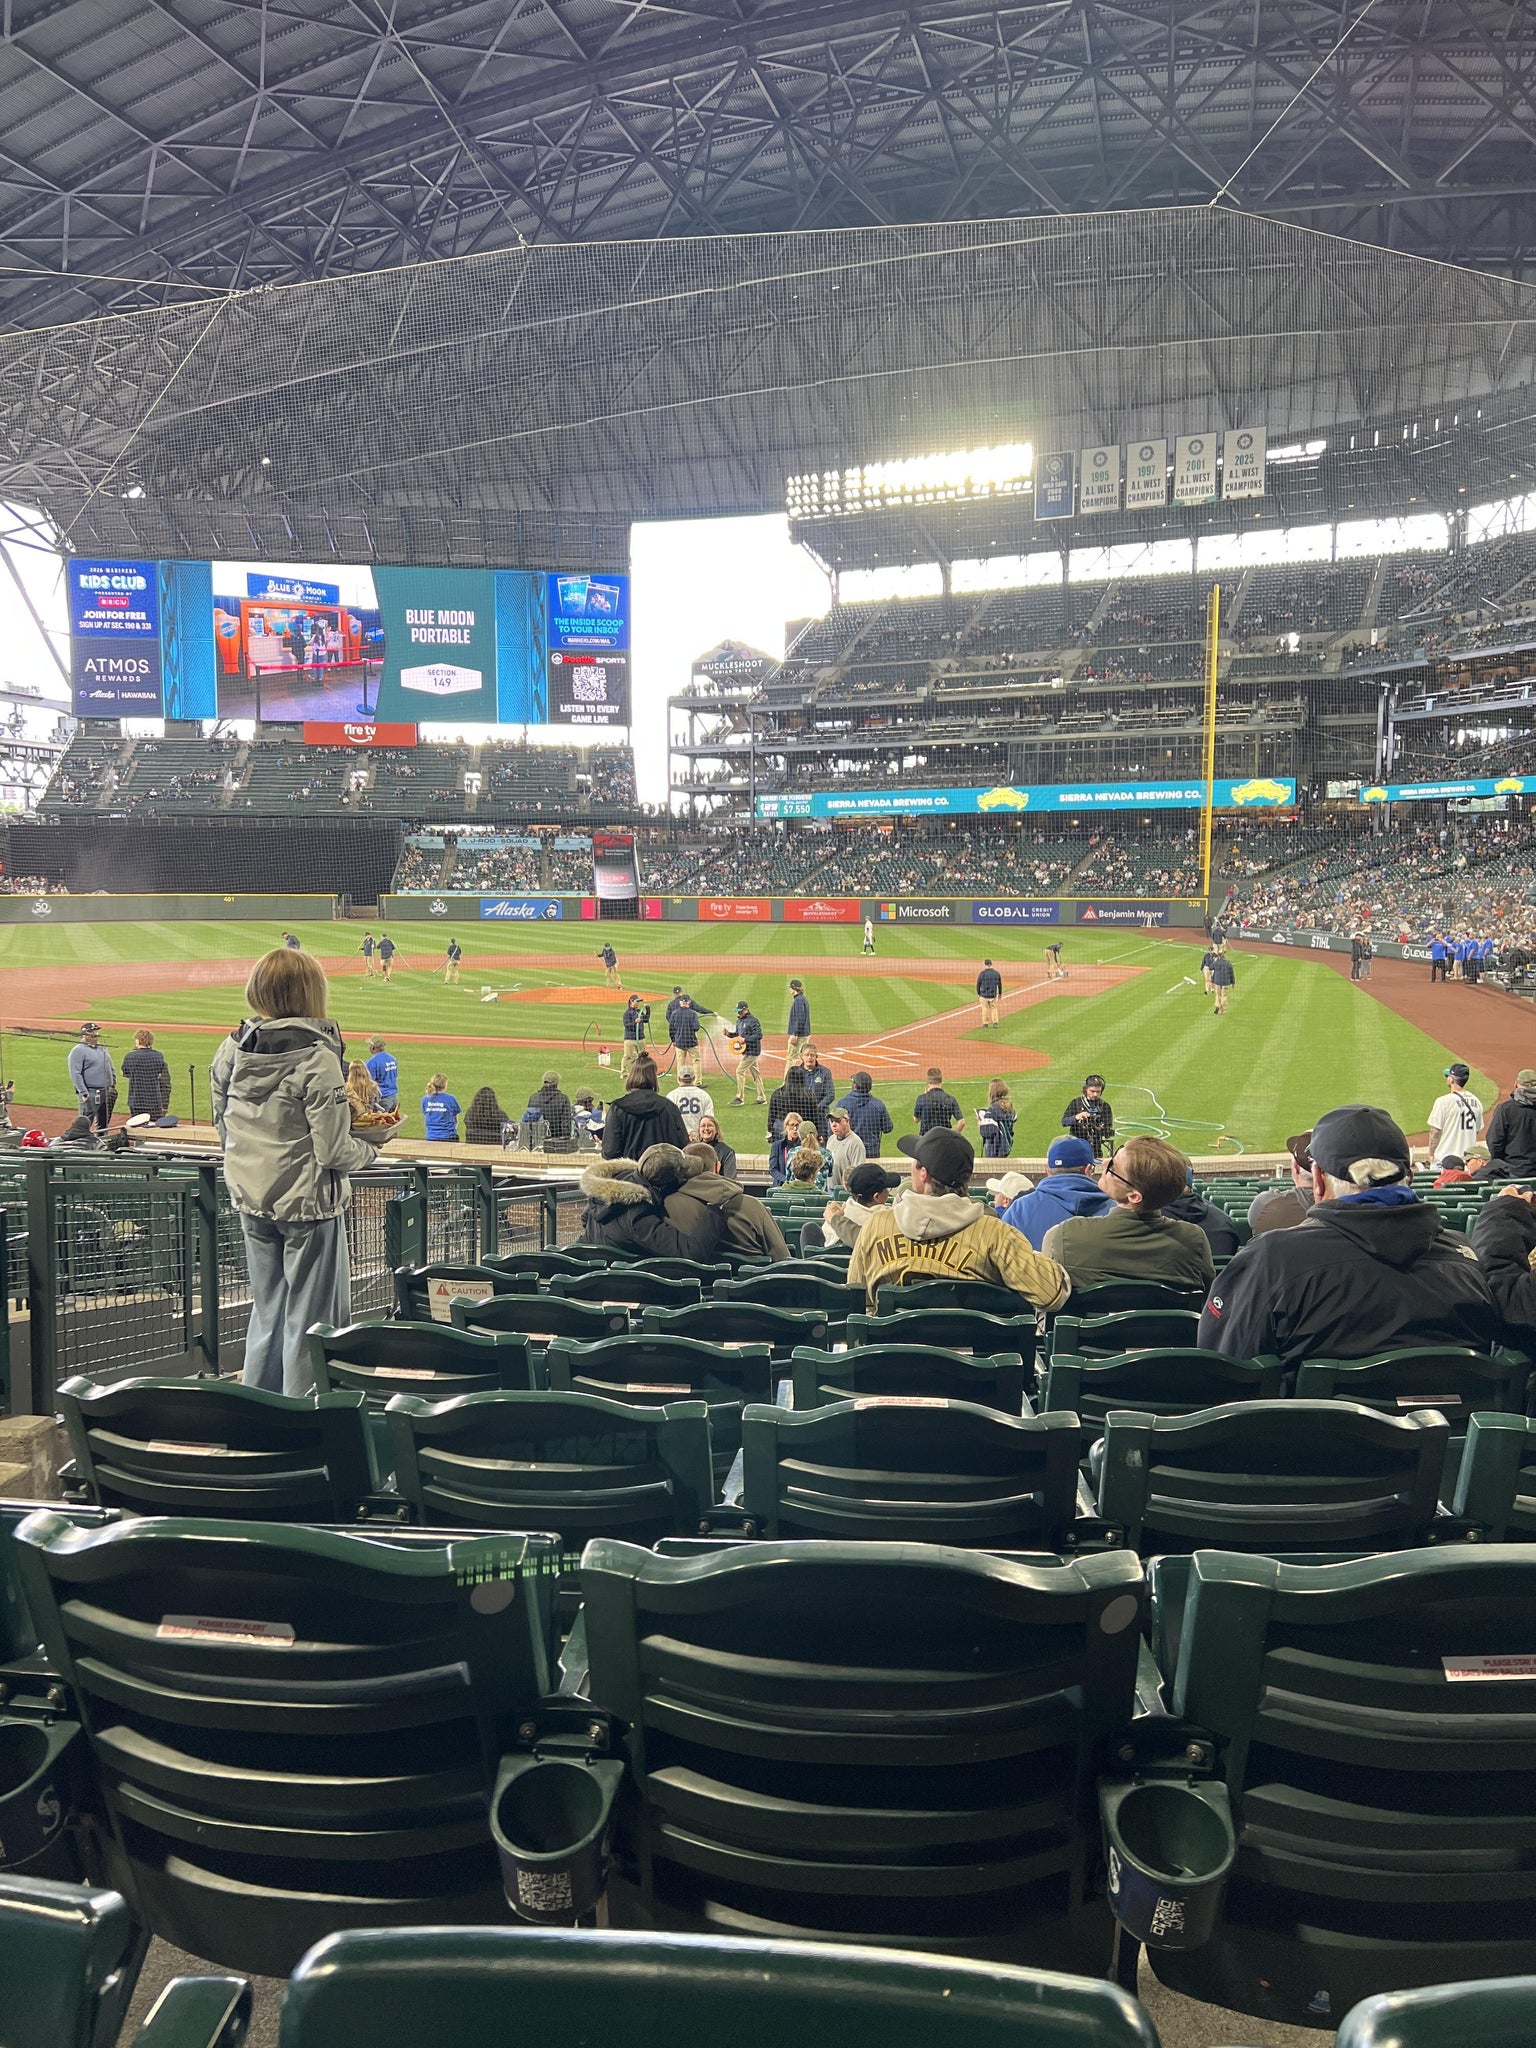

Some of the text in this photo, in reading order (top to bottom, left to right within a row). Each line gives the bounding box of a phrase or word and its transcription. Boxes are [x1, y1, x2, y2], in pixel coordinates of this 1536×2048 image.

[1186, 459, 1205, 471] 2001
[1234, 454, 1254, 466] 2025
[1091, 471, 1109, 482] 1995
[1138, 465, 1155, 477] 1997
[1242, 468, 1259, 478] WEST
[1144, 479, 1160, 488] WEST
[1192, 473, 1210, 483] WEST
[1097, 484, 1114, 494] WEST
[1176, 485, 1214, 498] CHAMPIONS
[1225, 480, 1262, 492] CHAMPIONS
[1082, 496, 1117, 508] CHAMPIONS
[1128, 490, 1164, 503] CHAMPIONS
[80, 574, 146, 590] KIDS CLUB
[267, 580, 290, 592] BLUE
[306, 586, 326, 596] MOON
[83, 611, 146, 620] JOIN FOR FREE
[406, 609, 474, 626] BLUE MOON
[411, 628, 470, 643] PORTABLE
[563, 655, 596, 664] Seattle
[702, 660, 763, 670] MUCKLESHOOT
[84, 658, 149, 674] ATMOS
[434, 678, 451, 686] 149
[89, 690, 115, 699] Alaska
[597, 705, 619, 713] EVERY
[344, 724, 376, 735] fire tv
[1059, 790, 1201, 802] SIERRA NEVADA BREWING CO.
[827, 797, 949, 808] SIERRA NEVADA BREWING CO.
[484, 901, 535, 918] Alaska
[899, 906, 950, 917] Microsoft
[979, 907, 1029, 917] GLOBAL
[1099, 910, 1135, 919] Benjamin
[1311, 935, 1330, 949] STIHL
[1410, 948, 1433, 959] LEXUS
[334, 1088, 345, 1098] HH
[679, 1096, 700, 1114] 26
[1461, 1111, 1474, 1130] 12
[877, 1234, 973, 1275] MERRILL
